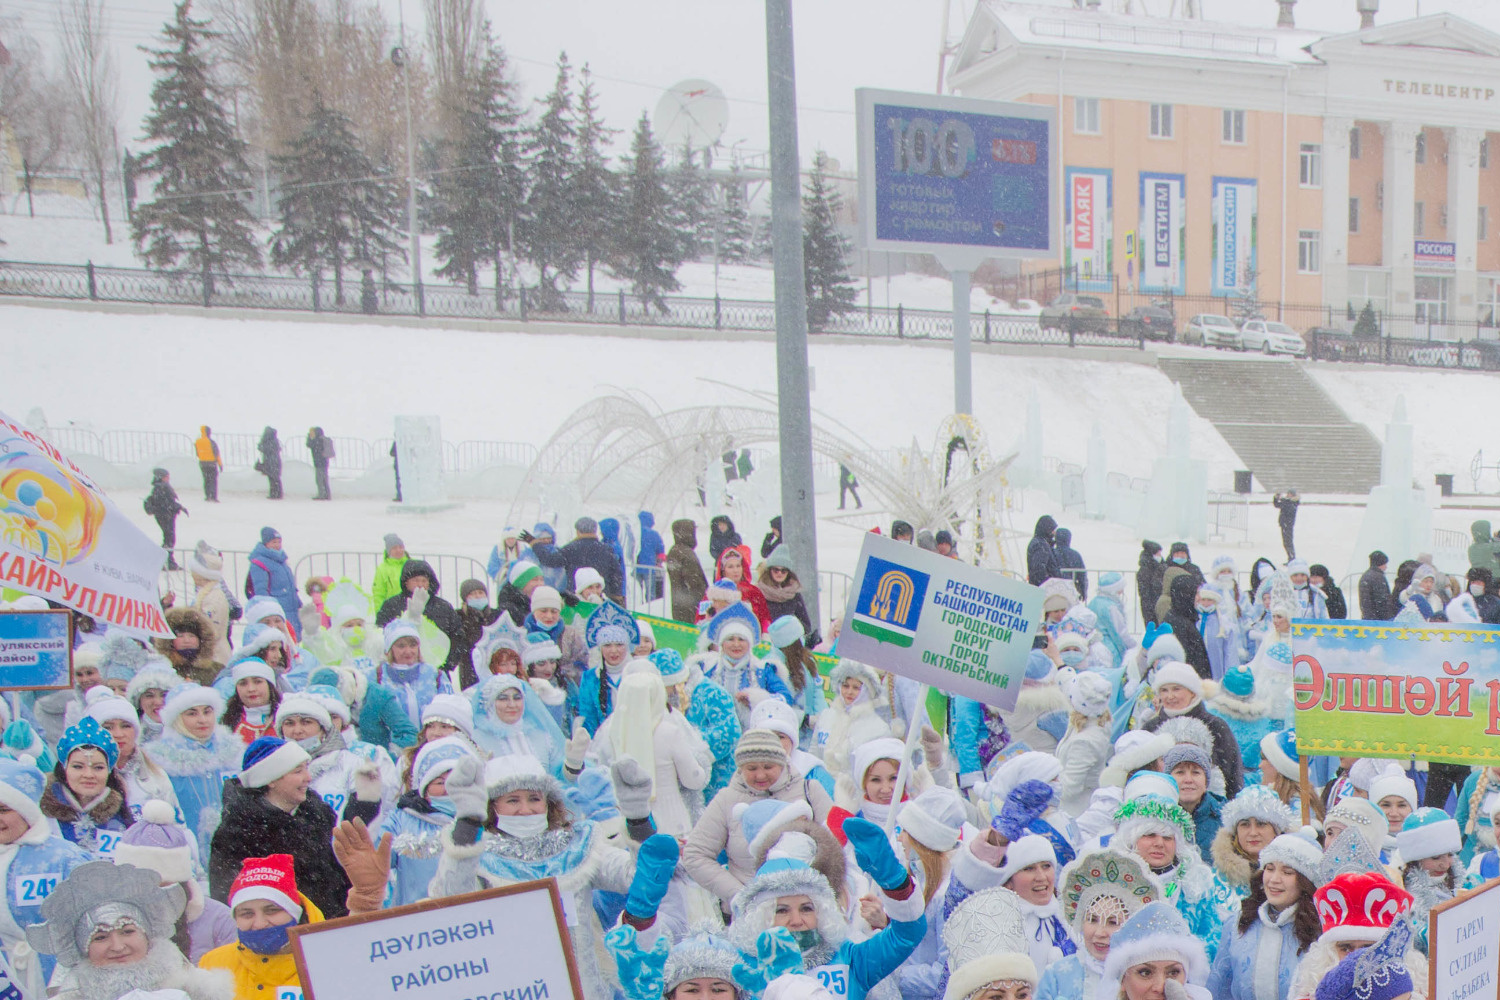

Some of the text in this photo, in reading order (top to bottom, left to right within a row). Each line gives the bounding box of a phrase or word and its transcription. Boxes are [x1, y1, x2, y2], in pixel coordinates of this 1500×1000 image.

[1383, 79, 1495, 100] ТЕЛЕЦЕНТР
[887, 117, 976, 178] 100
[1076, 183, 1092, 243] МАЯК
[1417, 243, 1453, 256] РОССИЯ
[933, 591, 1029, 633] БАШКОРТОСТАН
[945, 579, 1024, 616] РЕСПУБЛИКА
[941, 609, 1013, 644] ГОРОДСКОЙ
[954, 629, 993, 652] ОКРУГ
[922, 650, 1010, 690] ОКТЯБРЬСКИЙ
[949, 643, 989, 669] ГОРОД
[1456, 915, 1485, 944] ГАРЕМ
[390, 957, 490, 992] РАЙОНЫ
[1449, 943, 1487, 977] СУЛТАНА
